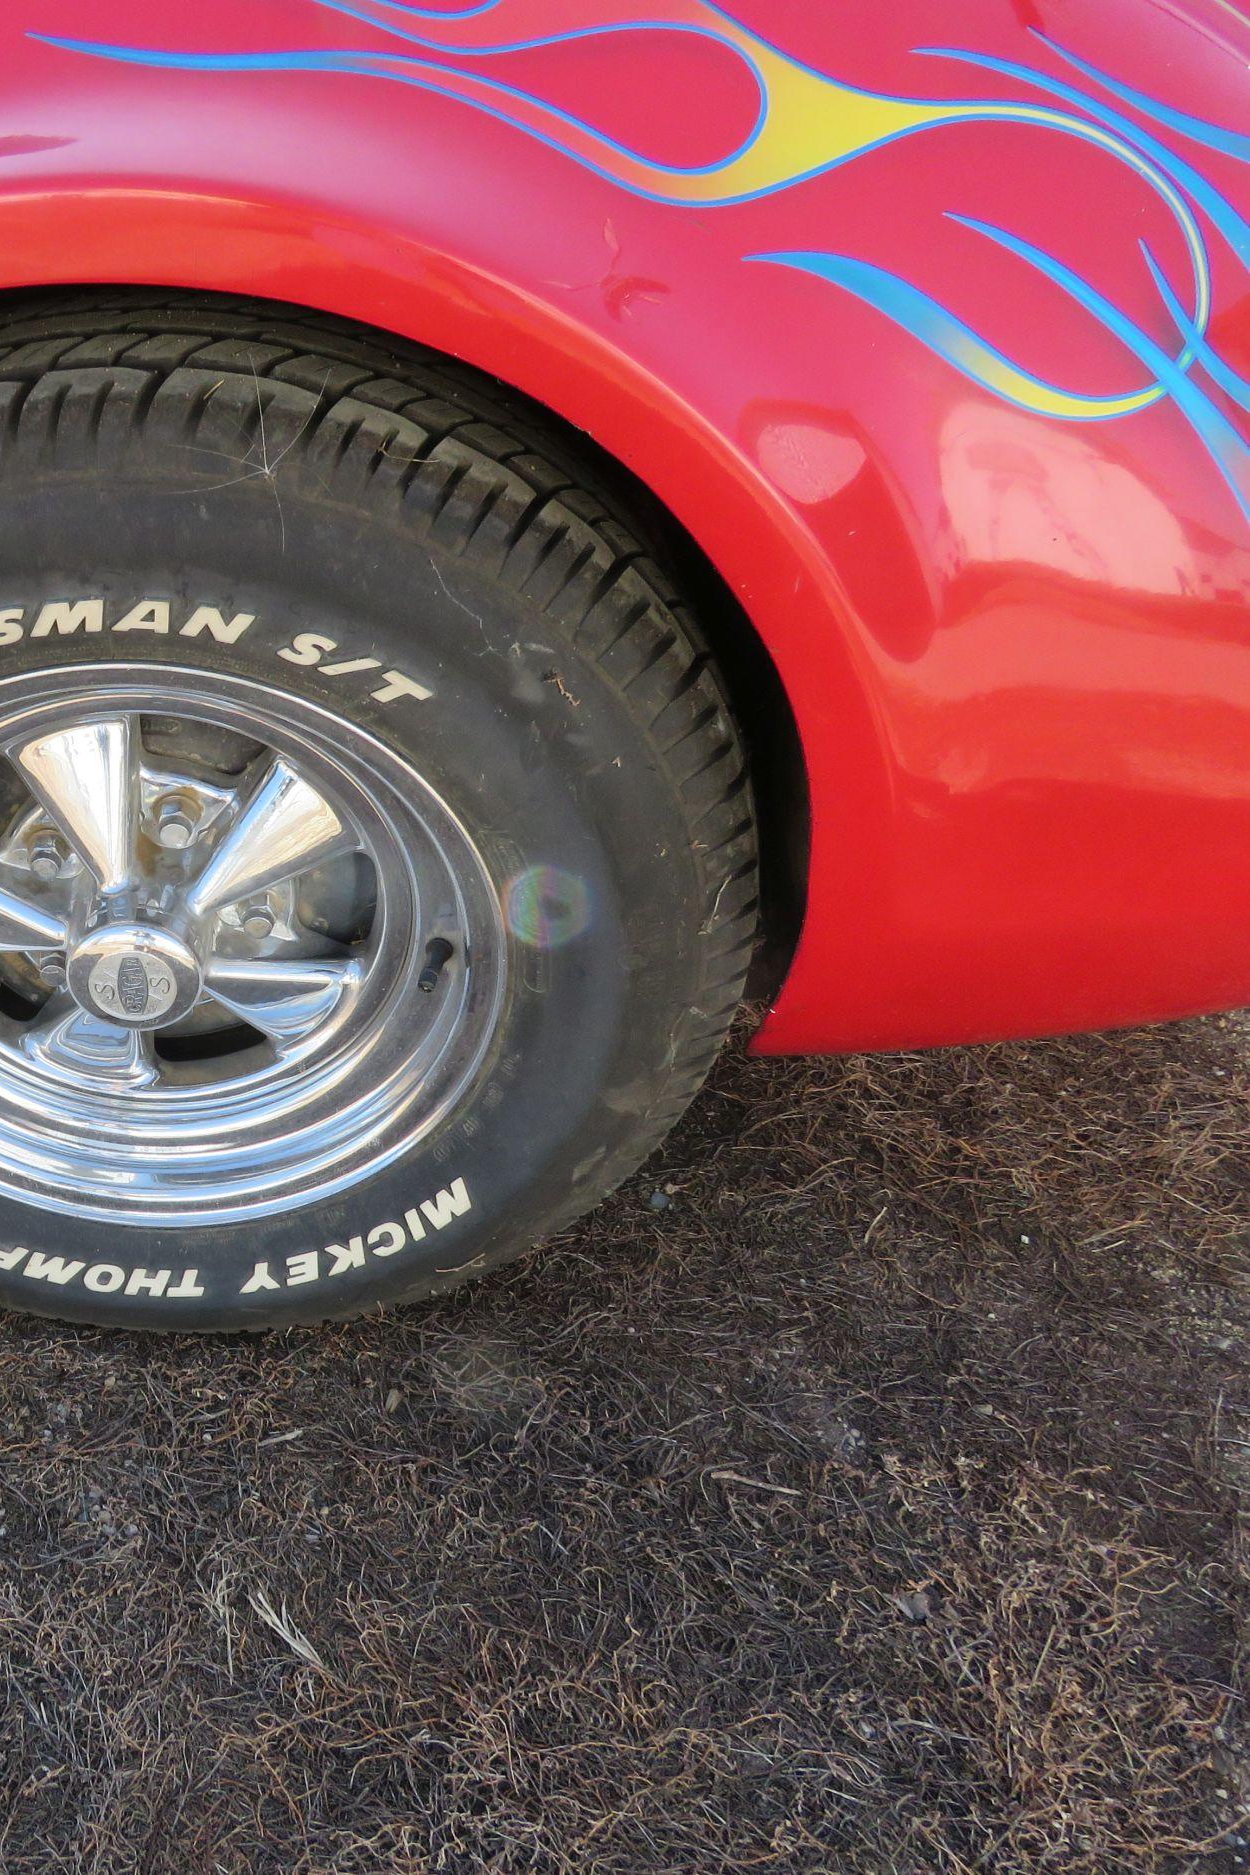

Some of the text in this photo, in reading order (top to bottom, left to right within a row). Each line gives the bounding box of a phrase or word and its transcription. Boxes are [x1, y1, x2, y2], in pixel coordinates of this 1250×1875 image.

[276, 633, 434, 703] S/T
[121, 958, 145, 1013] CRAGAR
[239, 1176, 472, 1294] MICKEY
